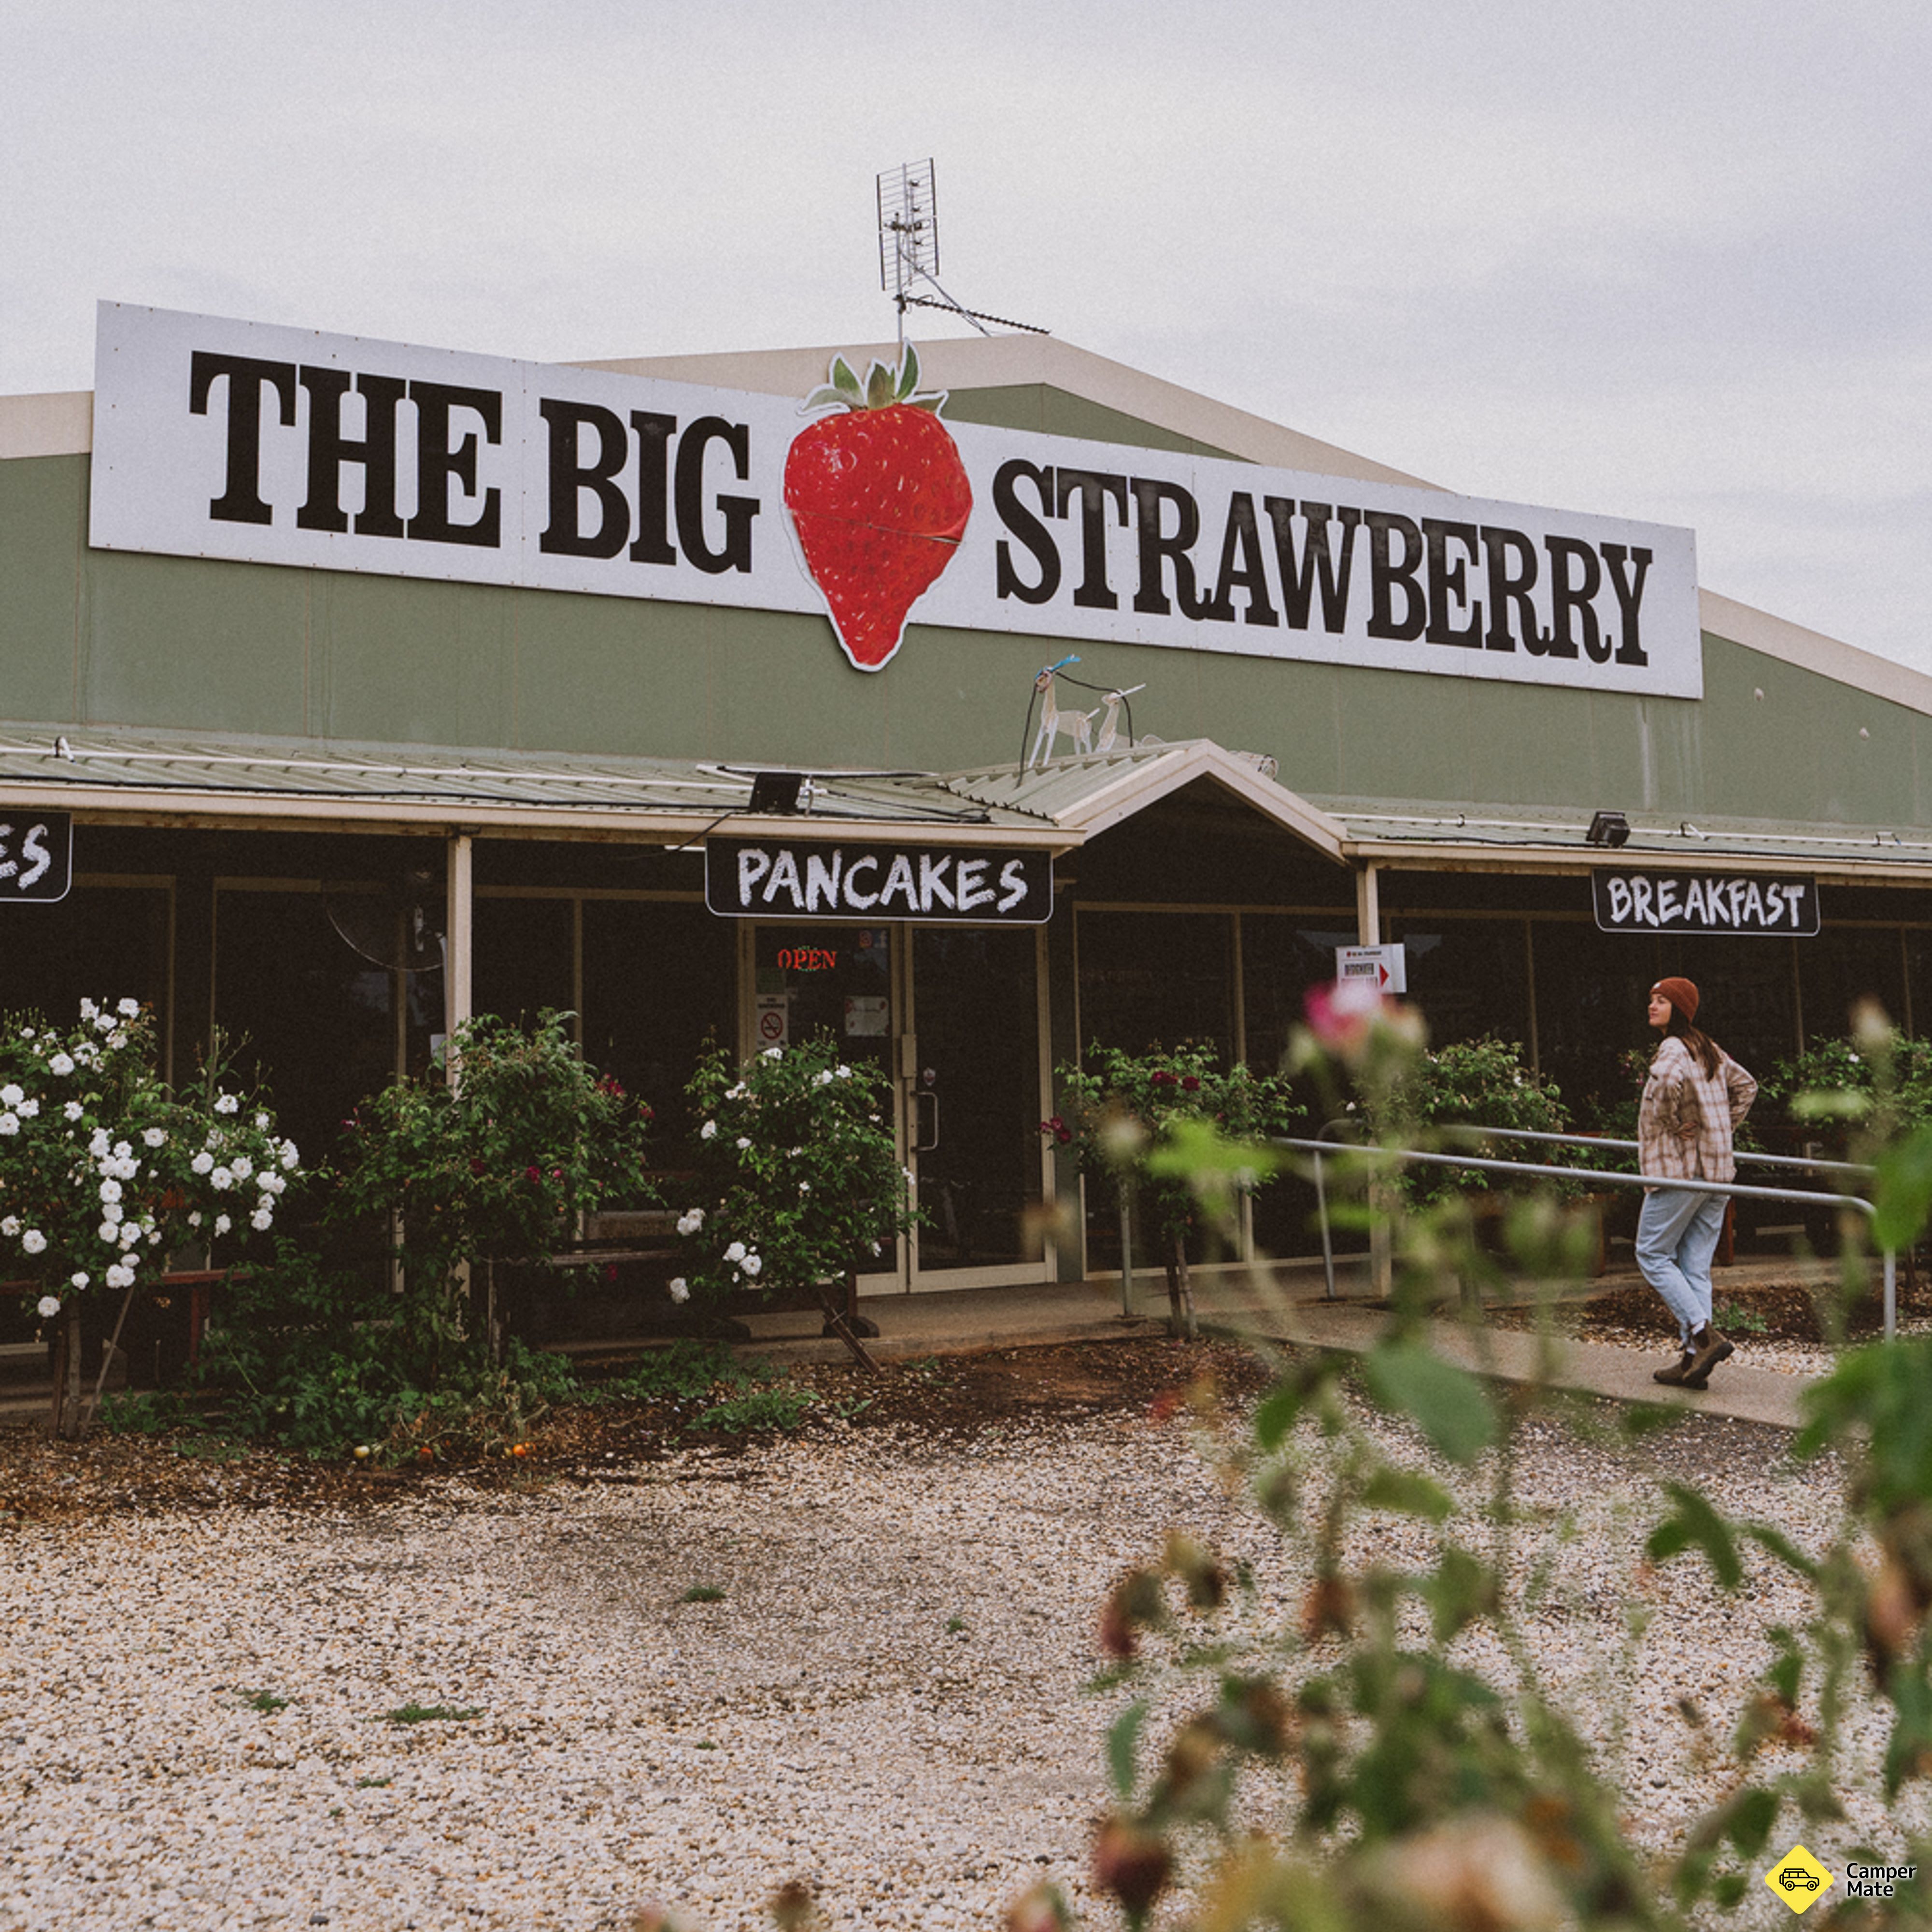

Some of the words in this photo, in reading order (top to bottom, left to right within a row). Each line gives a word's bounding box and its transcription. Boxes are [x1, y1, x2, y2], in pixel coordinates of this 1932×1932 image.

[189, 350, 502, 548] THE
[540, 398, 760, 574] BIG
[992, 459, 1653, 667] STRAWBERRY
[737, 849, 1028, 912] PANCAKES
[1607, 876, 1805, 927] BREAKFAST
[778, 949, 837, 969] OPEN
